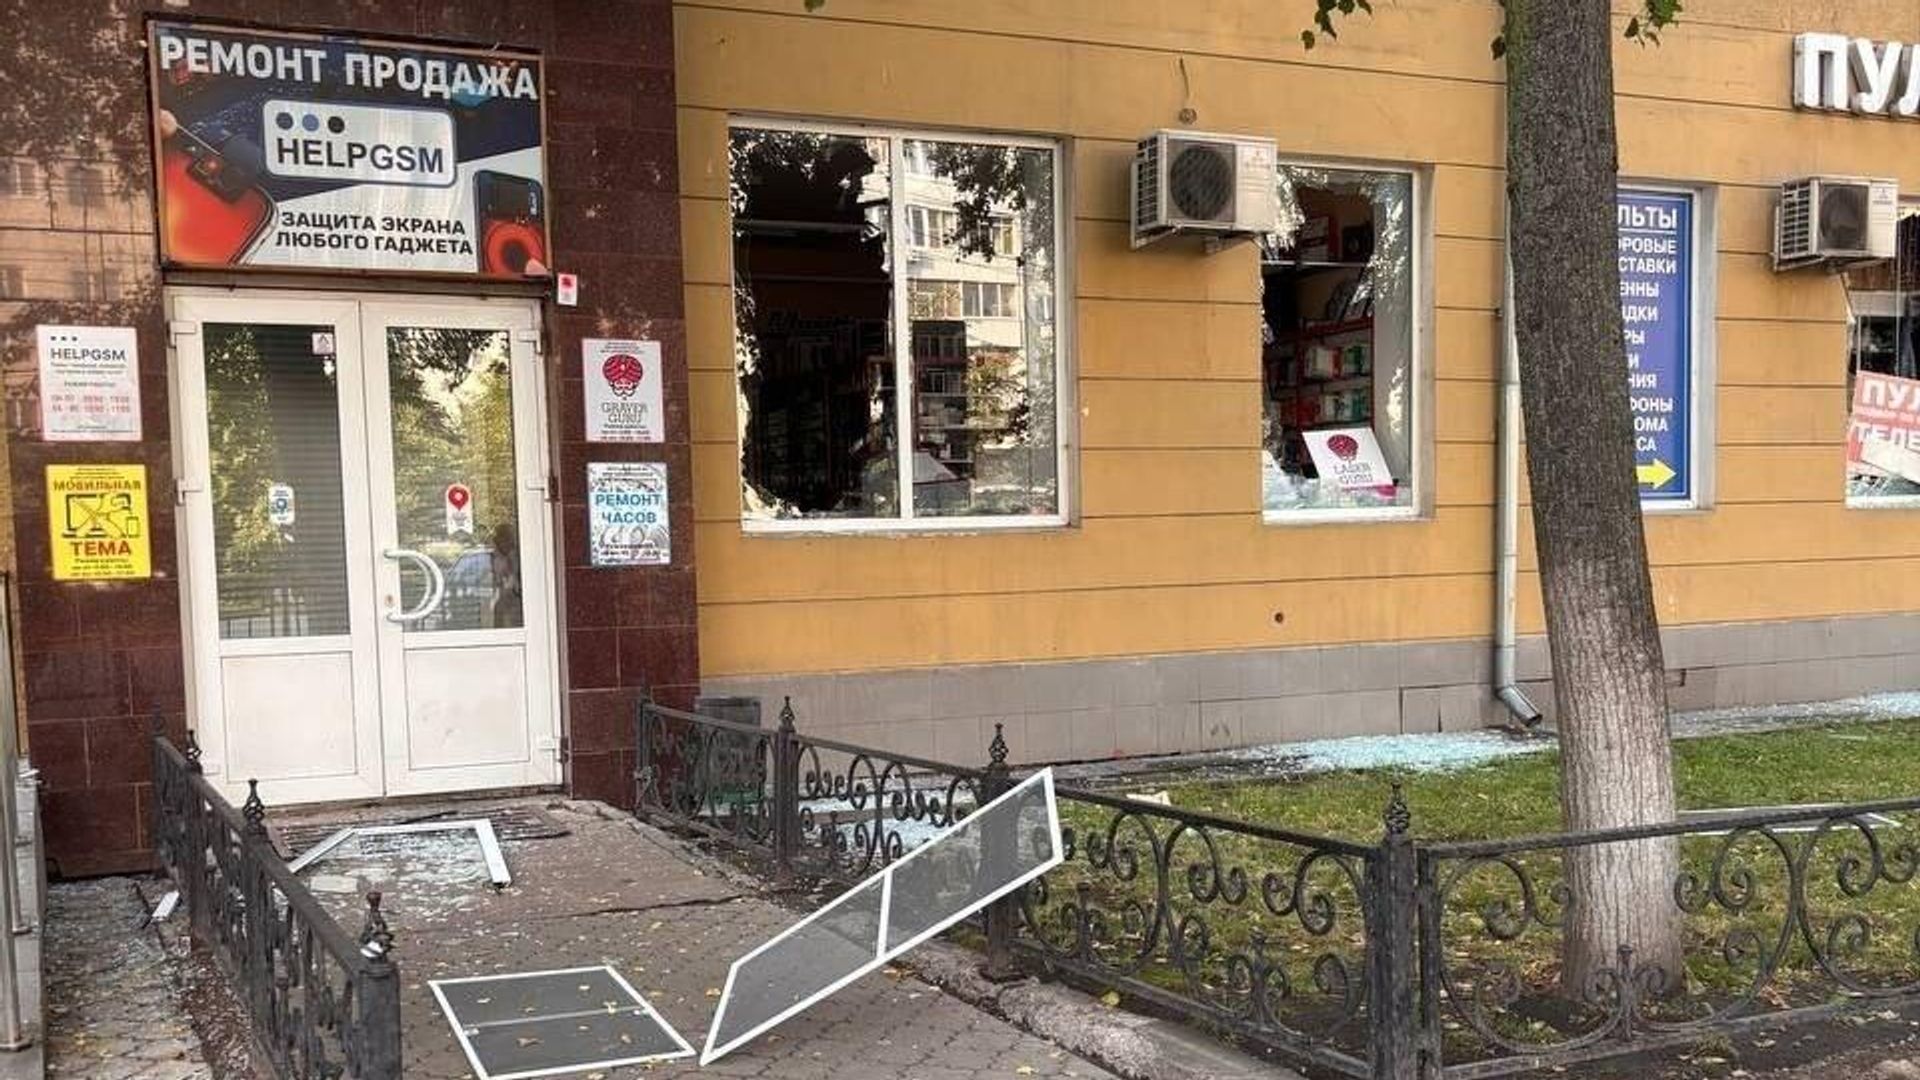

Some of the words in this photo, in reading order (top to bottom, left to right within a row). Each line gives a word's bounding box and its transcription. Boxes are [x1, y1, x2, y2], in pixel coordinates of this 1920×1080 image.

[159, 35, 327, 83] РЕМОНТ
[345, 53, 538, 100] ПРОДАЖА
[276, 138, 443, 173] HELPGSM
[281, 211, 376, 232] ЗАЩИТА
[381, 216, 466, 236] ЭКРАНА
[1617, 204, 1677, 229] ЛЬТЫ
[275, 231, 369, 251] ЛЮБОГО
[374, 236, 473, 256] ГАДЖЕТА
[1618, 237, 1677, 254] РОВЫЕ
[1618, 257, 1677, 274] СТАВКИ
[50, 348, 127, 361] HELPGSM
[1633, 416, 1669, 432] ОМА
[53, 480, 142, 491] МОБИЛЬНАЯ
[595, 494, 662, 506] РЕМОНТ
[601, 511, 657, 524] ЧАСОВ
[70, 540, 132, 556] ТЕМА
